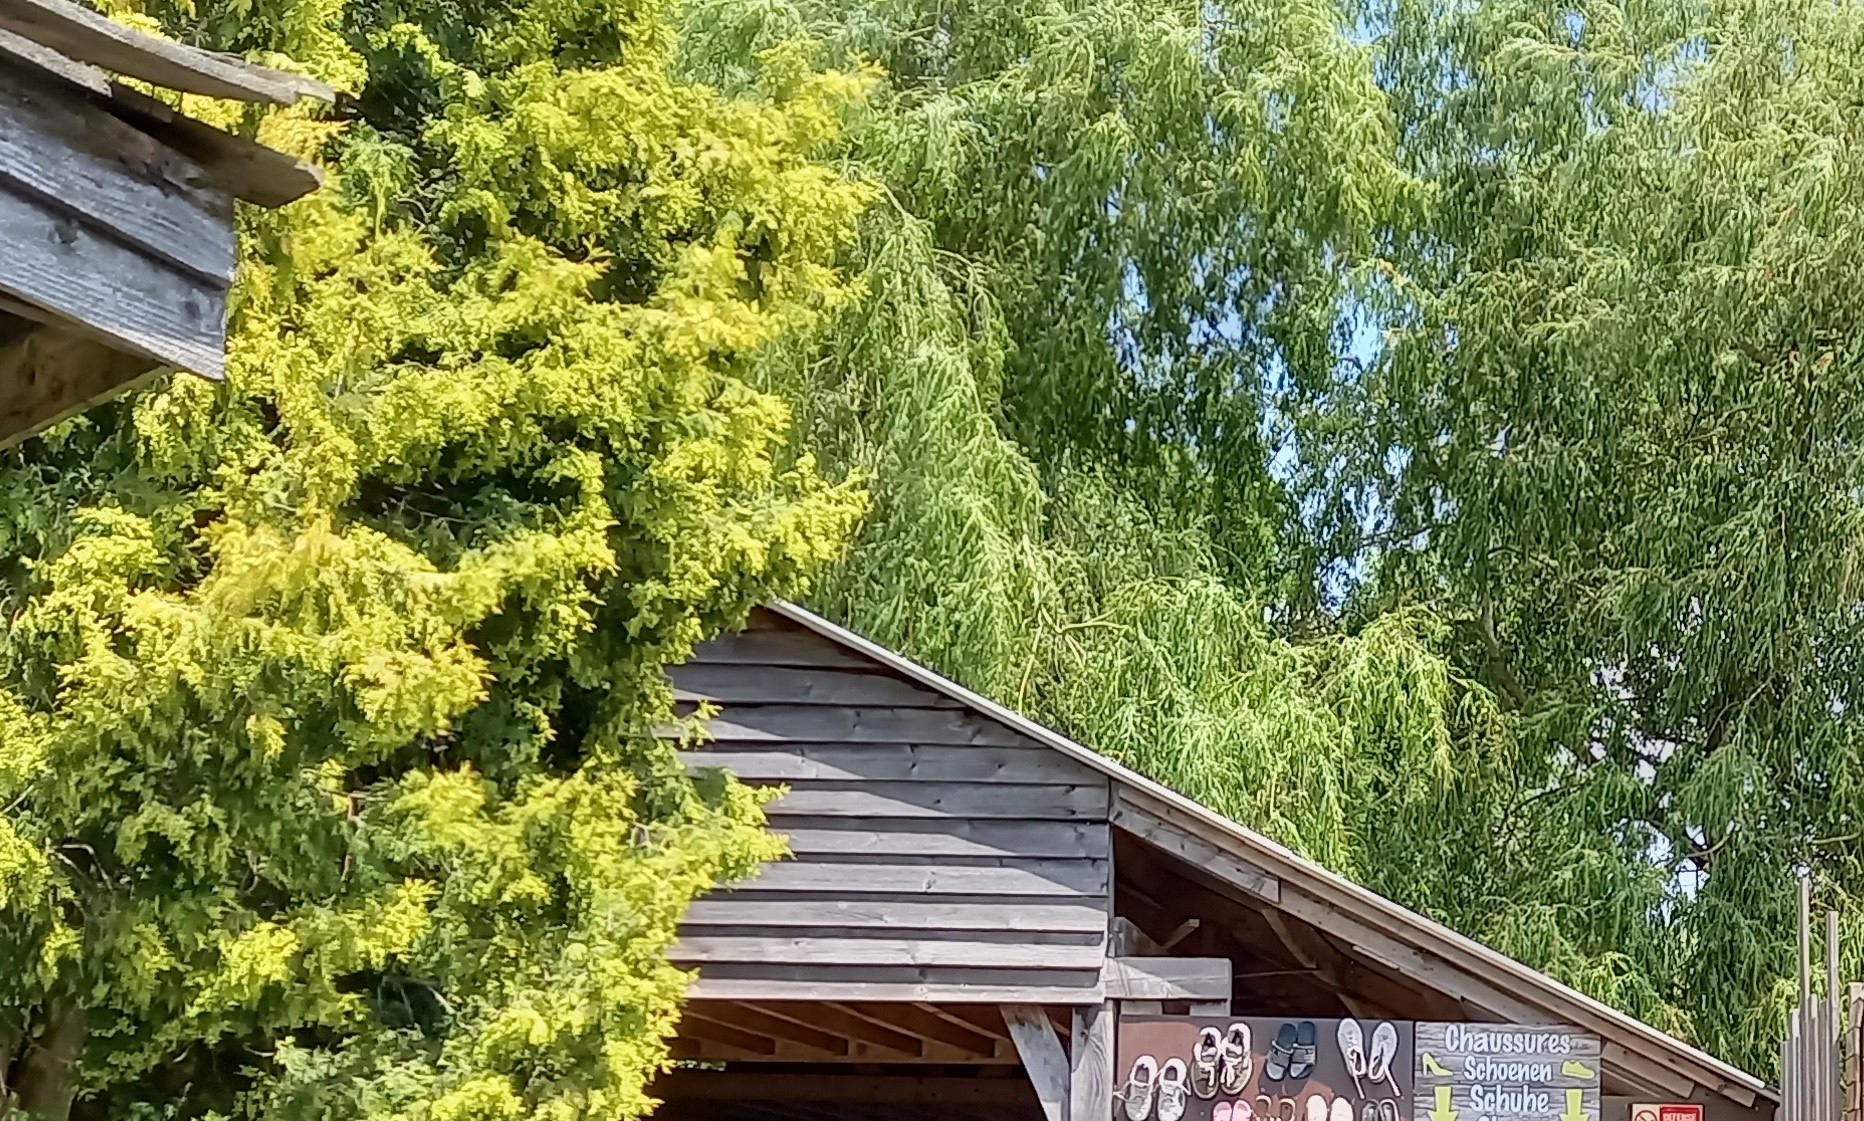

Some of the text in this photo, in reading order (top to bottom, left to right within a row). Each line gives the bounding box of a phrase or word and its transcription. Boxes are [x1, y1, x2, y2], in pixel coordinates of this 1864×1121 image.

[1446, 1024, 1571, 1053] Chaussures
[1464, 1055, 1552, 1081] Schoenen
[1470, 1085, 1549, 1112] Schuhe
